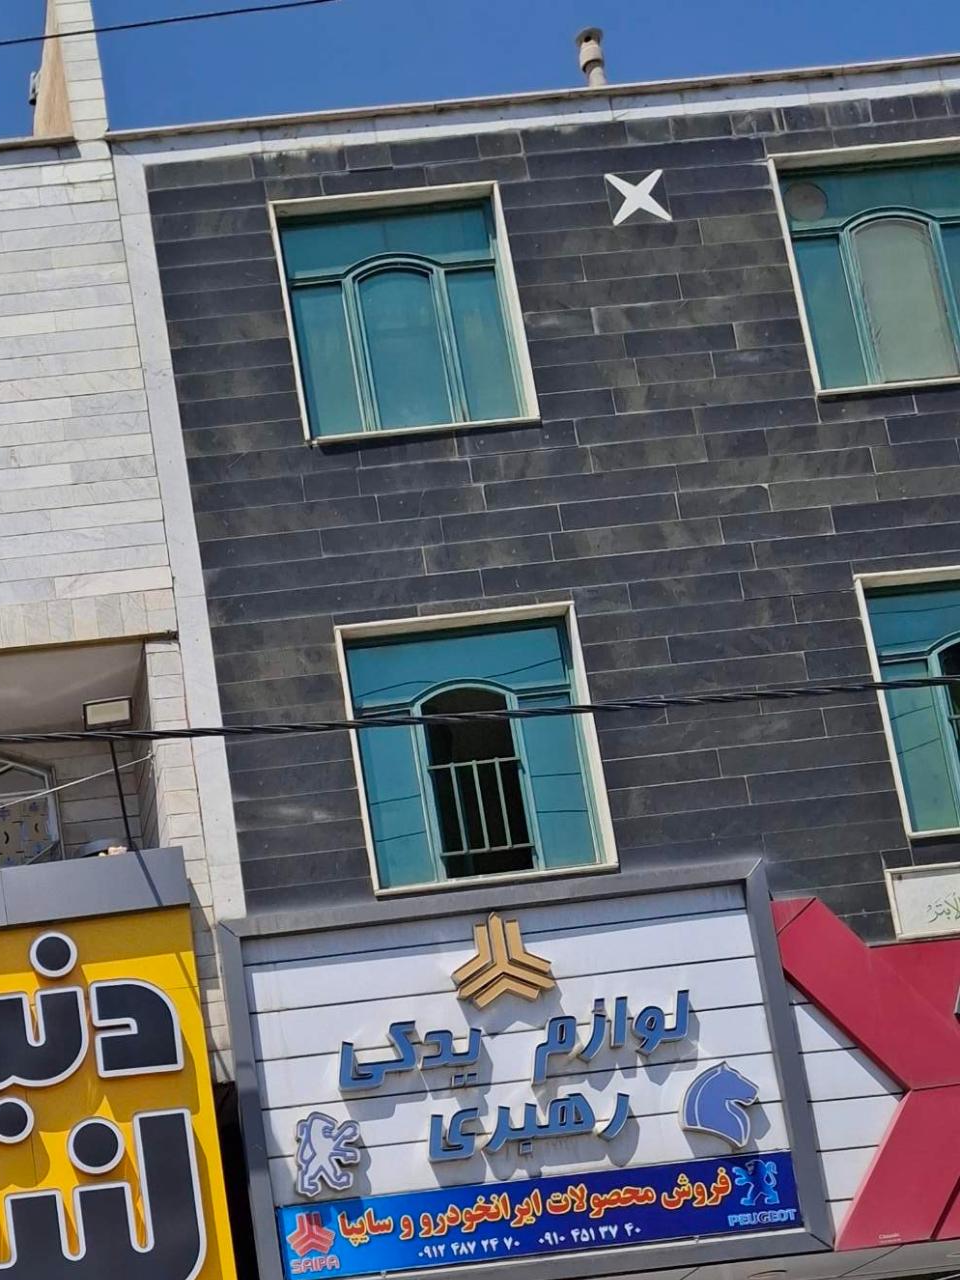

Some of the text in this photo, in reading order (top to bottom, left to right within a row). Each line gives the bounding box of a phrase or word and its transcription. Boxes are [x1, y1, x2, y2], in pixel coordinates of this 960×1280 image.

[338, 989, 690, 1092] لوازم یدکی
[427, 1092, 630, 1164] رهبری
[546, 1183, 656, 1219] محصولات
[661, 1167, 733, 1209] فروش
[338, 1207, 394, 1247] سایپا
[399, 1213, 416, 1241] و
[728, 1208, 797, 1227] PEUGEOT
[291, 1255, 340, 1274] SAIPA
